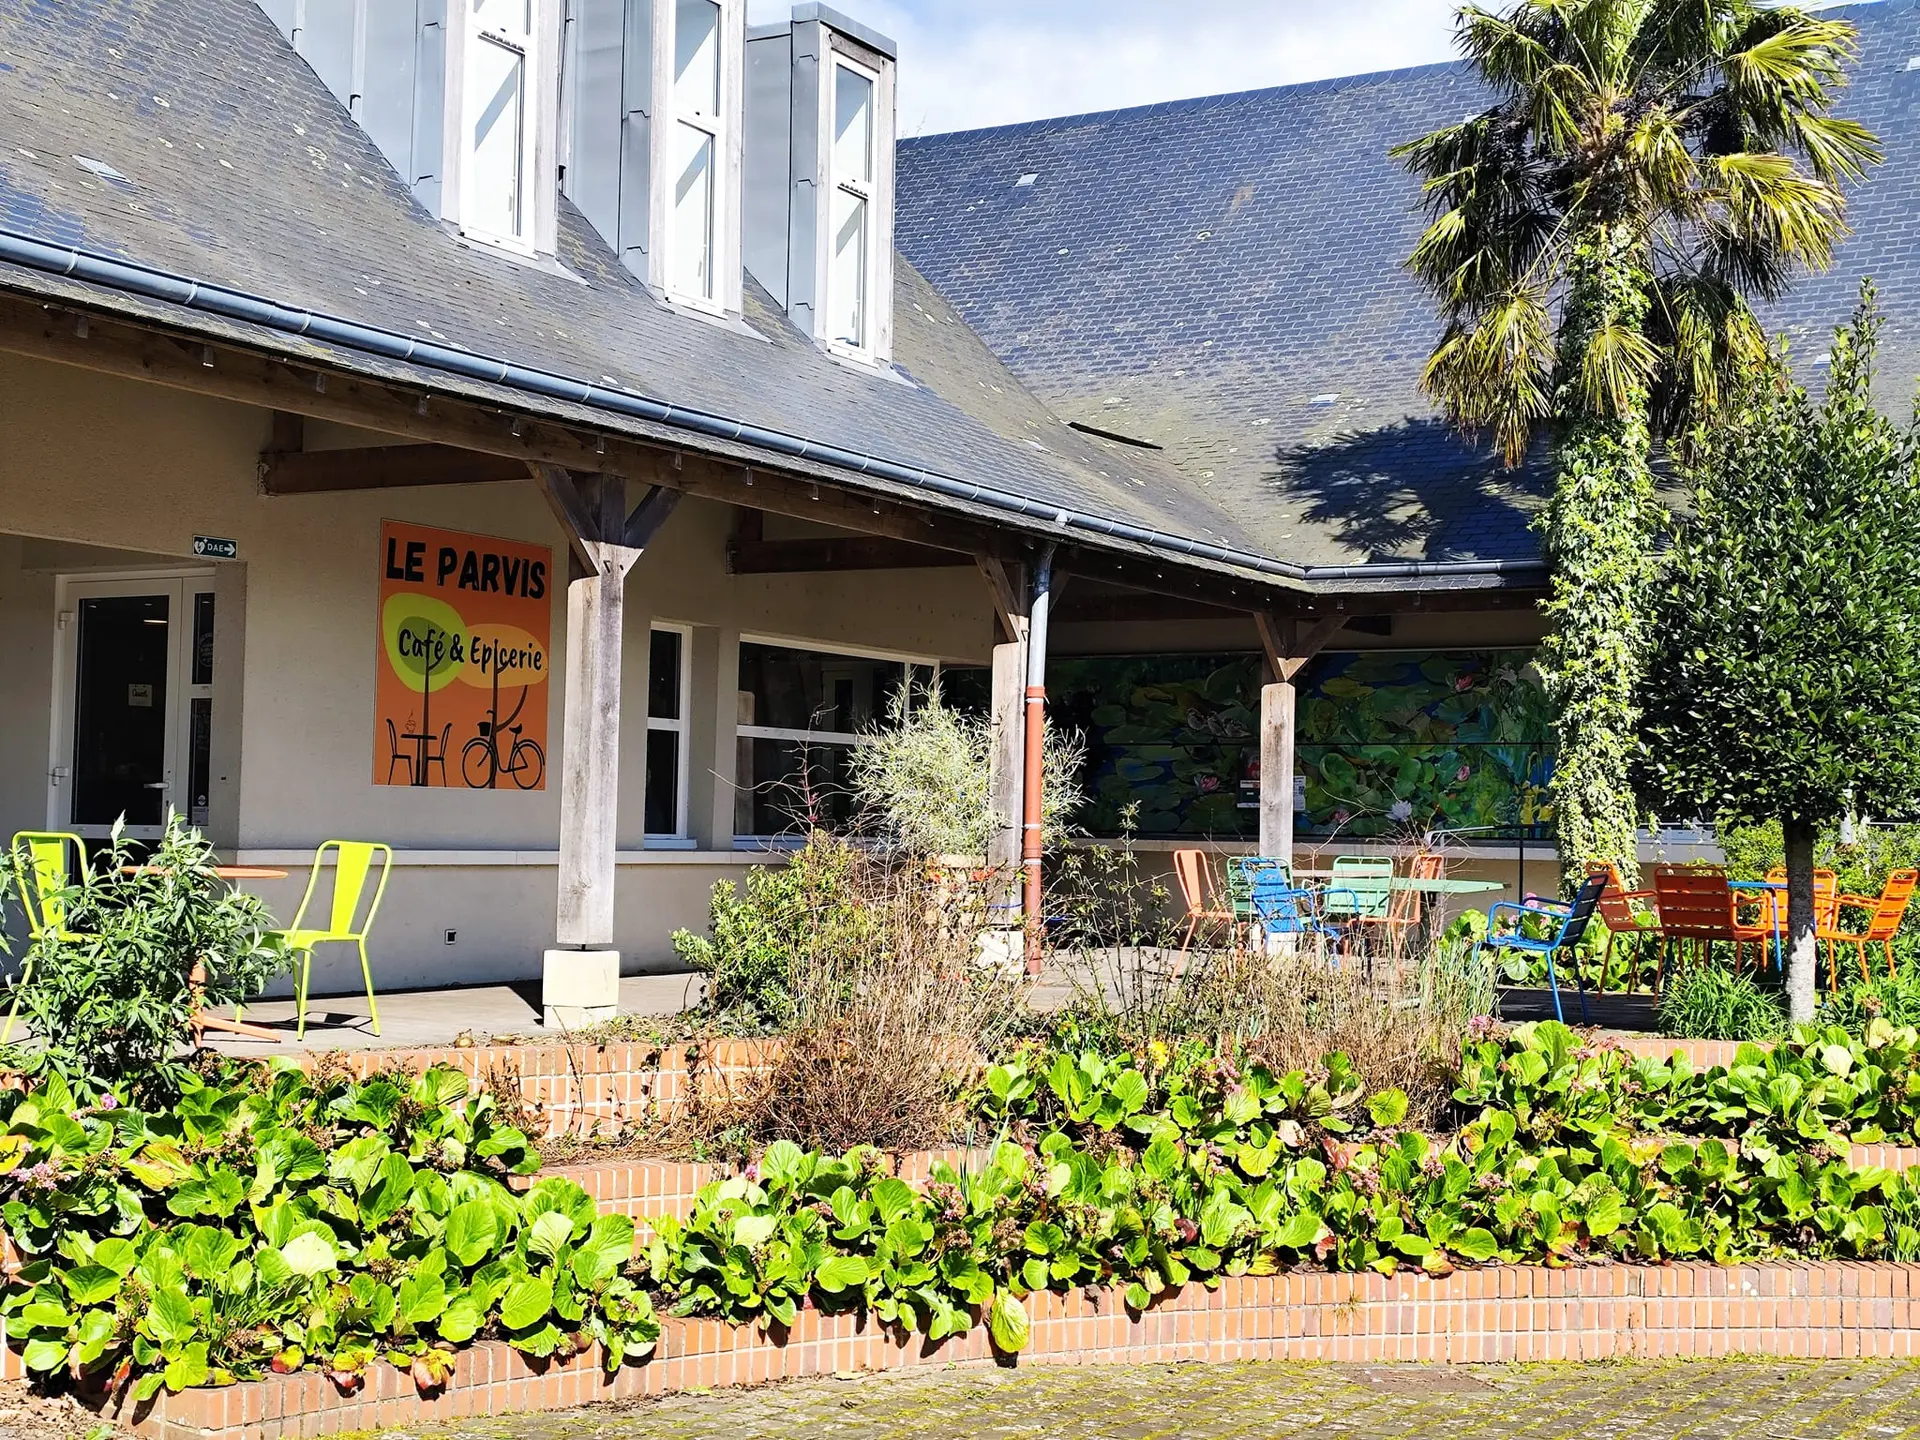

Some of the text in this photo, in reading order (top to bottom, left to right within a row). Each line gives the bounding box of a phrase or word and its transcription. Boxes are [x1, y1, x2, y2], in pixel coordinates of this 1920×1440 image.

[207, 543, 224, 552] DAE
[386, 537, 545, 600] LE PARVIS
[398, 628, 543, 674] Café & Epicerie
